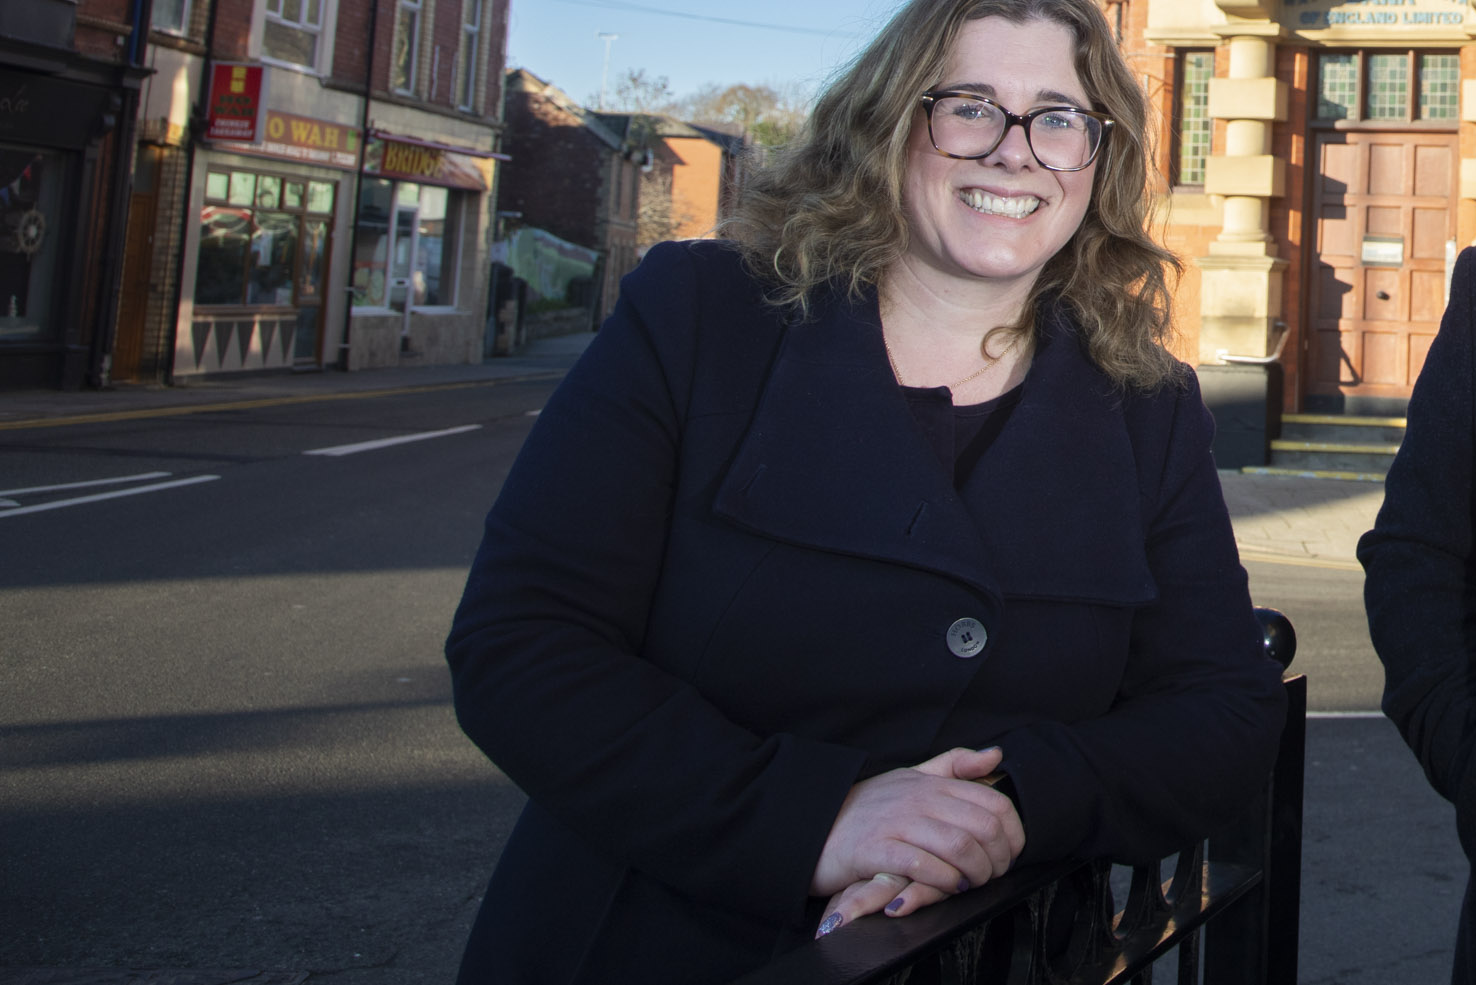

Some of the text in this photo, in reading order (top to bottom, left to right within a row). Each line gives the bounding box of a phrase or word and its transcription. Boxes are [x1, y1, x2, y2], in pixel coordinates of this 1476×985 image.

[1300, 11, 1464, 24] OF ENGLAND LIMITED
[269, 116, 285, 139] O
[290, 119, 340, 148] WAH
[384, 142, 443, 178] BRIDGE
[951, 620, 976, 636] HOBBS
